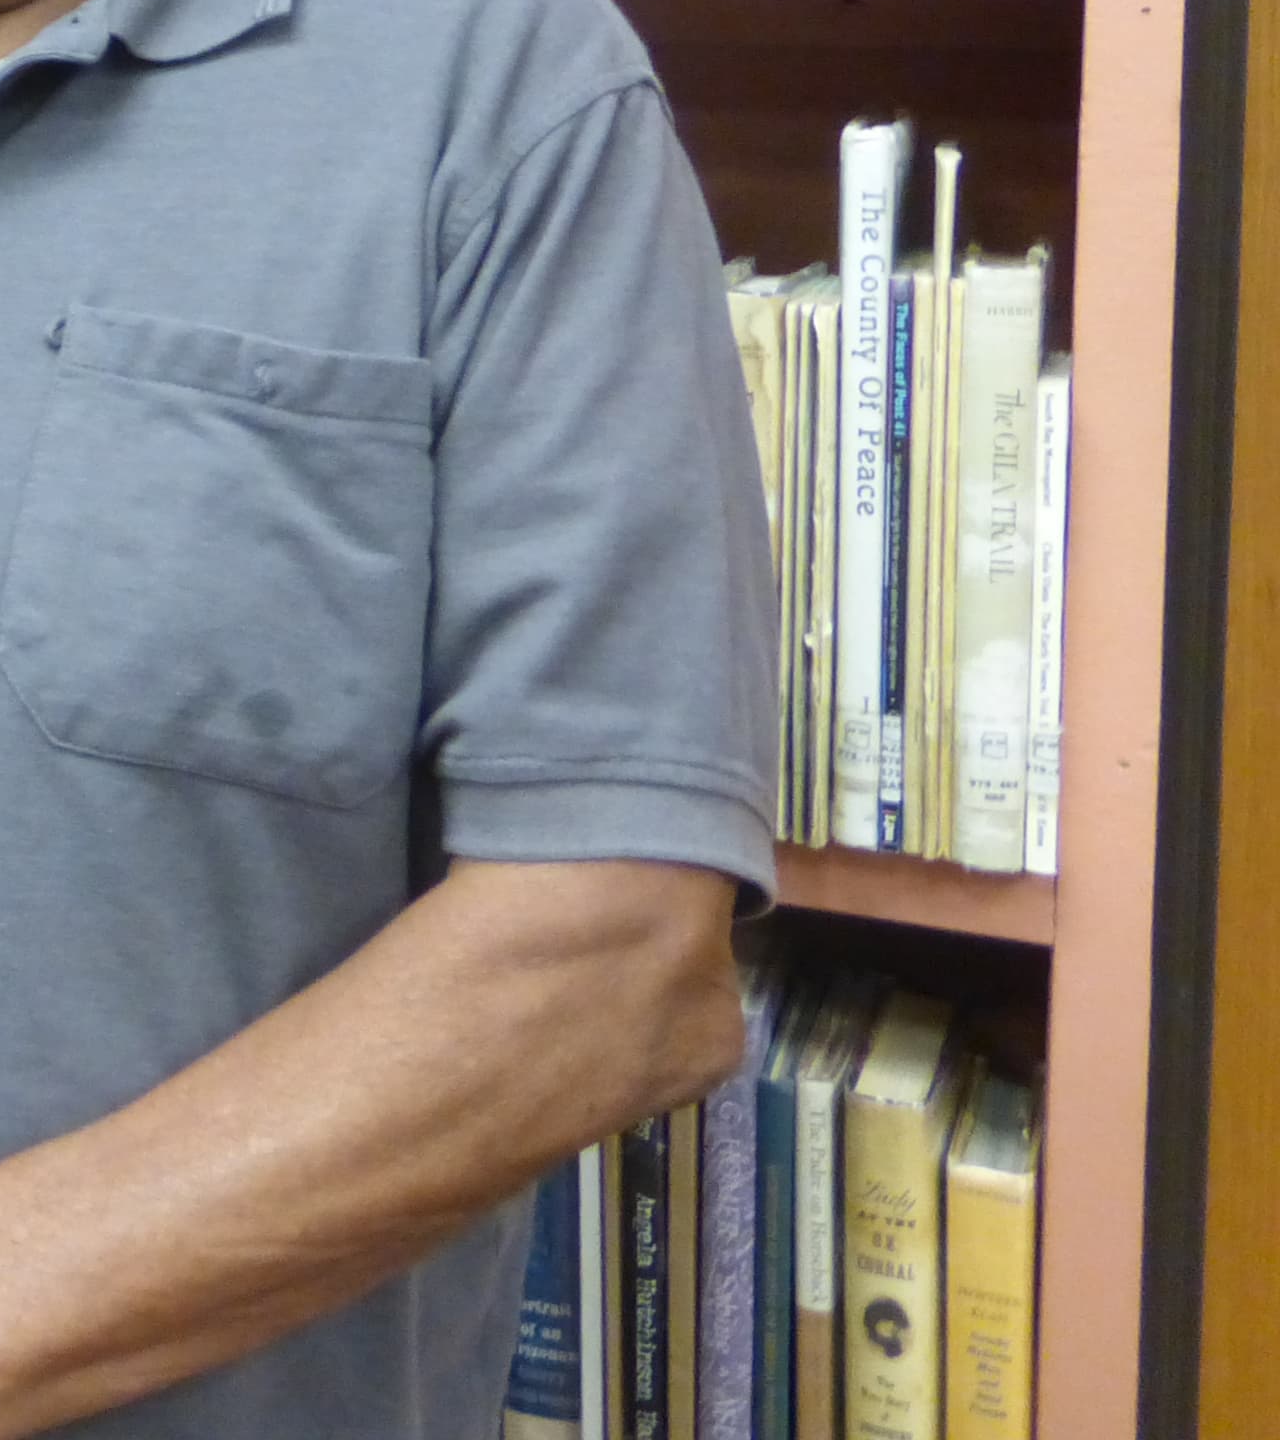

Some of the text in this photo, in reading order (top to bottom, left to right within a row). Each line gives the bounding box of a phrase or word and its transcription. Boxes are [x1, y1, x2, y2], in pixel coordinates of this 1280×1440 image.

[851, 188, 887, 517] The County Of Peace
[894, 302, 909, 366] The Faces
[989, 431, 1021, 585] GILA TRAIL
[856, 1253, 916, 1281] CORRAL
